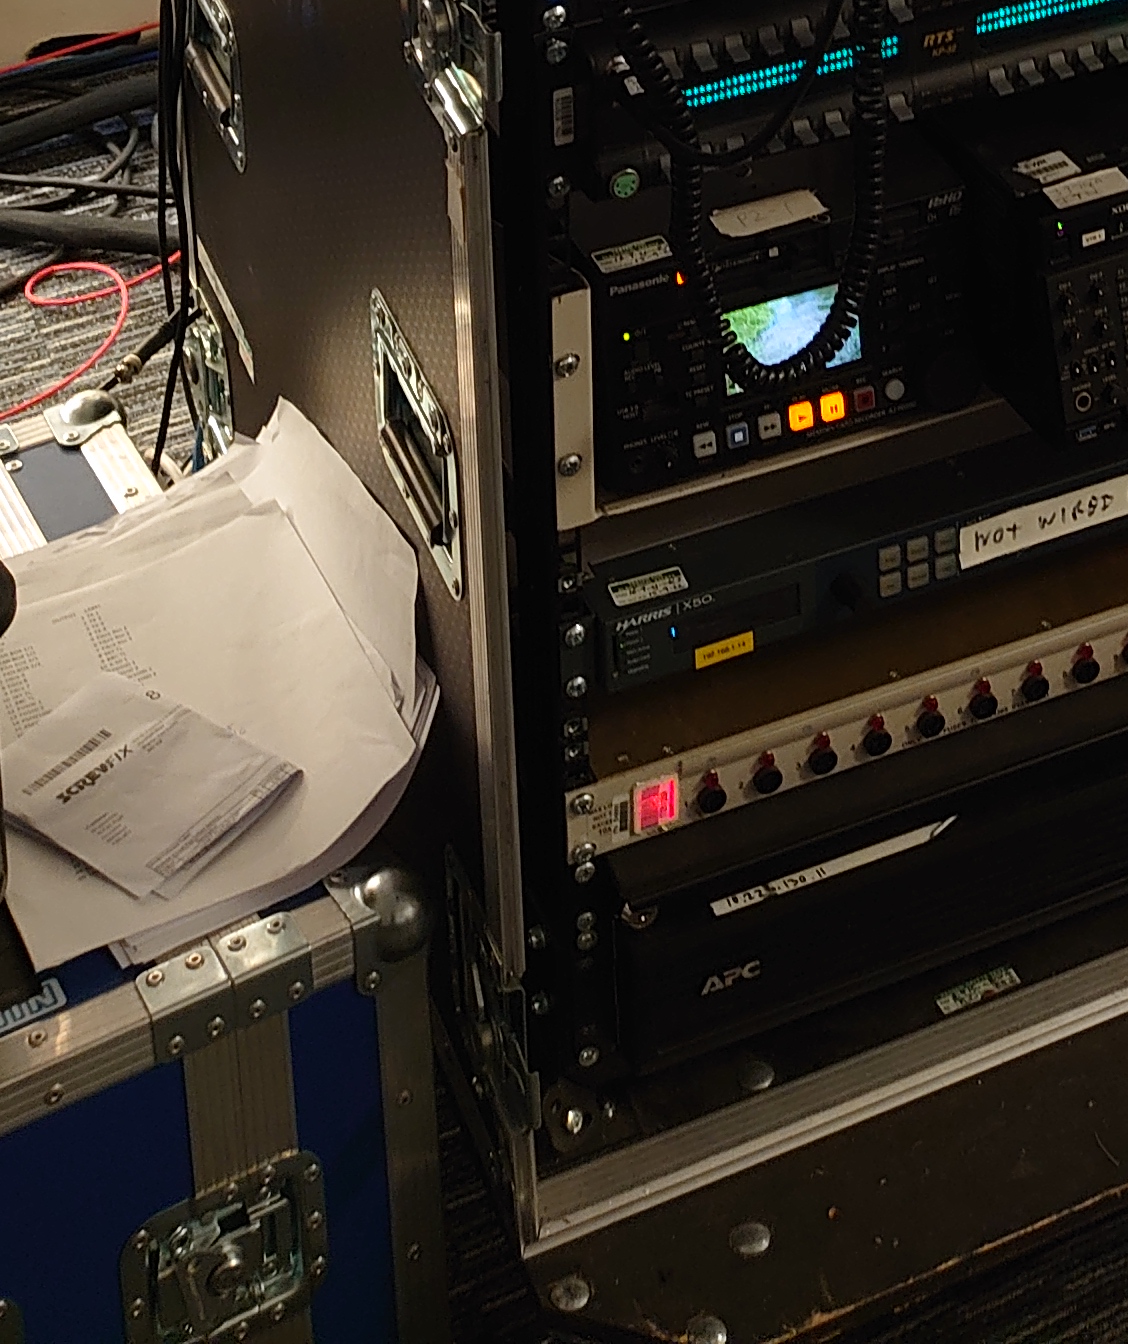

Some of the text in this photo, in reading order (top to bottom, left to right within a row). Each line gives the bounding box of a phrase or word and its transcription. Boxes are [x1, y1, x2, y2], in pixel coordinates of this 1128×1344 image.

[923, 28, 955, 49] RTS
[608, 273, 670, 298] Panasonic
[616, 606, 673, 632] HARRIS
[55, 743, 134, 805] SCREWFIX
[700, 958, 762, 998] APC
